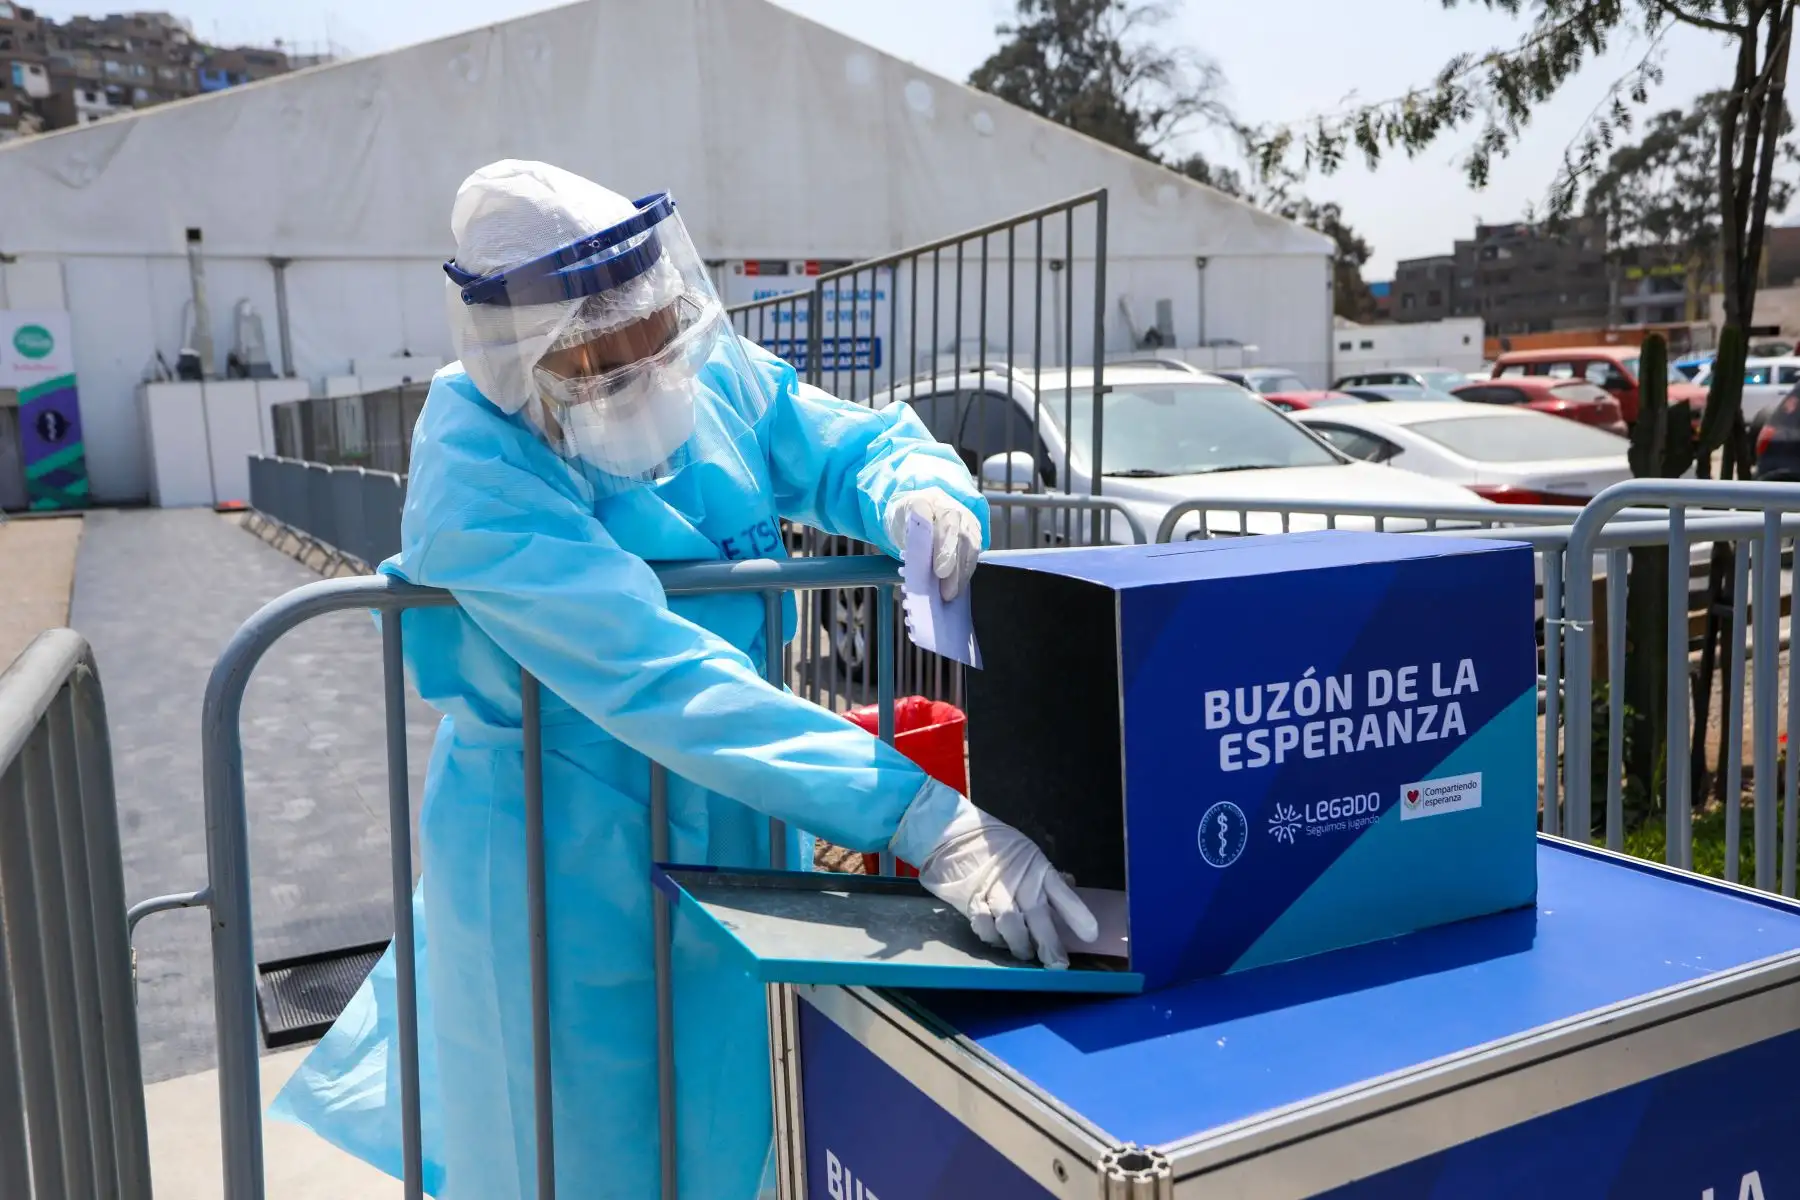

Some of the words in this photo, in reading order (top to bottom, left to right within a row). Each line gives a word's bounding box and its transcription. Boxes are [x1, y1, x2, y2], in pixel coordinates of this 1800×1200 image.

[1204, 666, 1353, 730] BUZÓN
[1367, 665, 1418, 708] DE
[1431, 658, 1480, 697] LA
[1219, 701, 1467, 772] ESPERANZA
[1424, 780, 1478, 796] Compartiendo
[1424, 794, 1462, 807] esperanza
[1305, 822, 1347, 836] Seguimos
[1347, 813, 1380, 832] jugando
